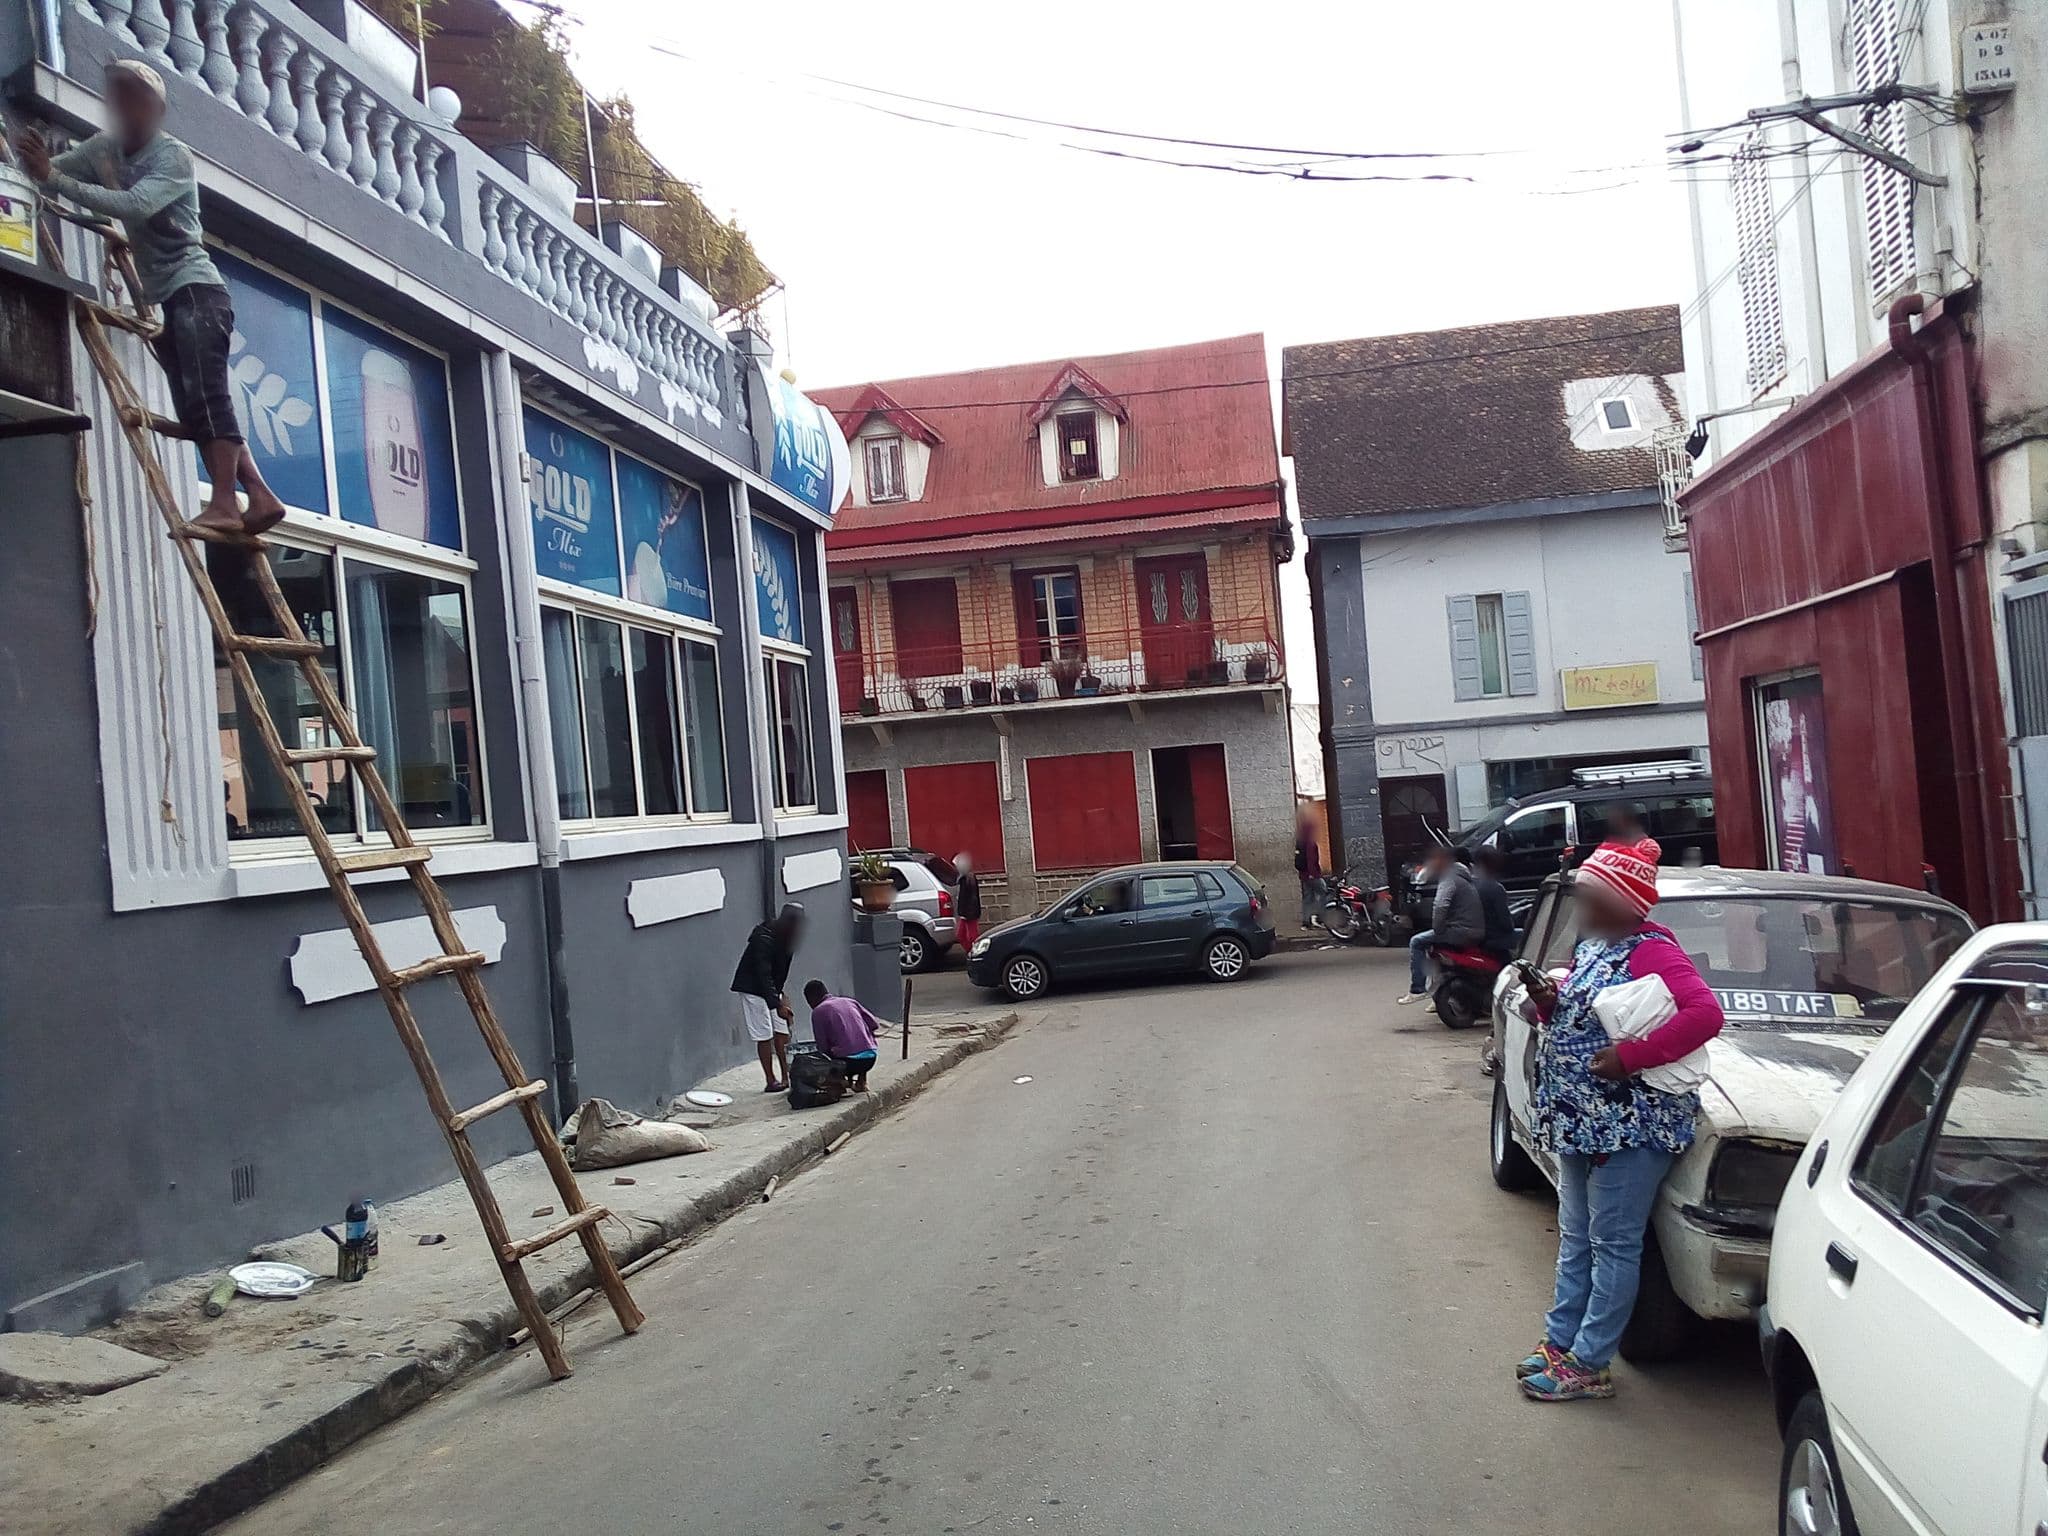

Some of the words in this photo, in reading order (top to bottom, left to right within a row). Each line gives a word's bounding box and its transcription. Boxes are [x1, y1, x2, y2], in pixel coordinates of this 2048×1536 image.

[530, 457, 591, 527] GOLD
[547, 527, 582, 558] Mix
[1775, 993, 1826, 1015] TAF
